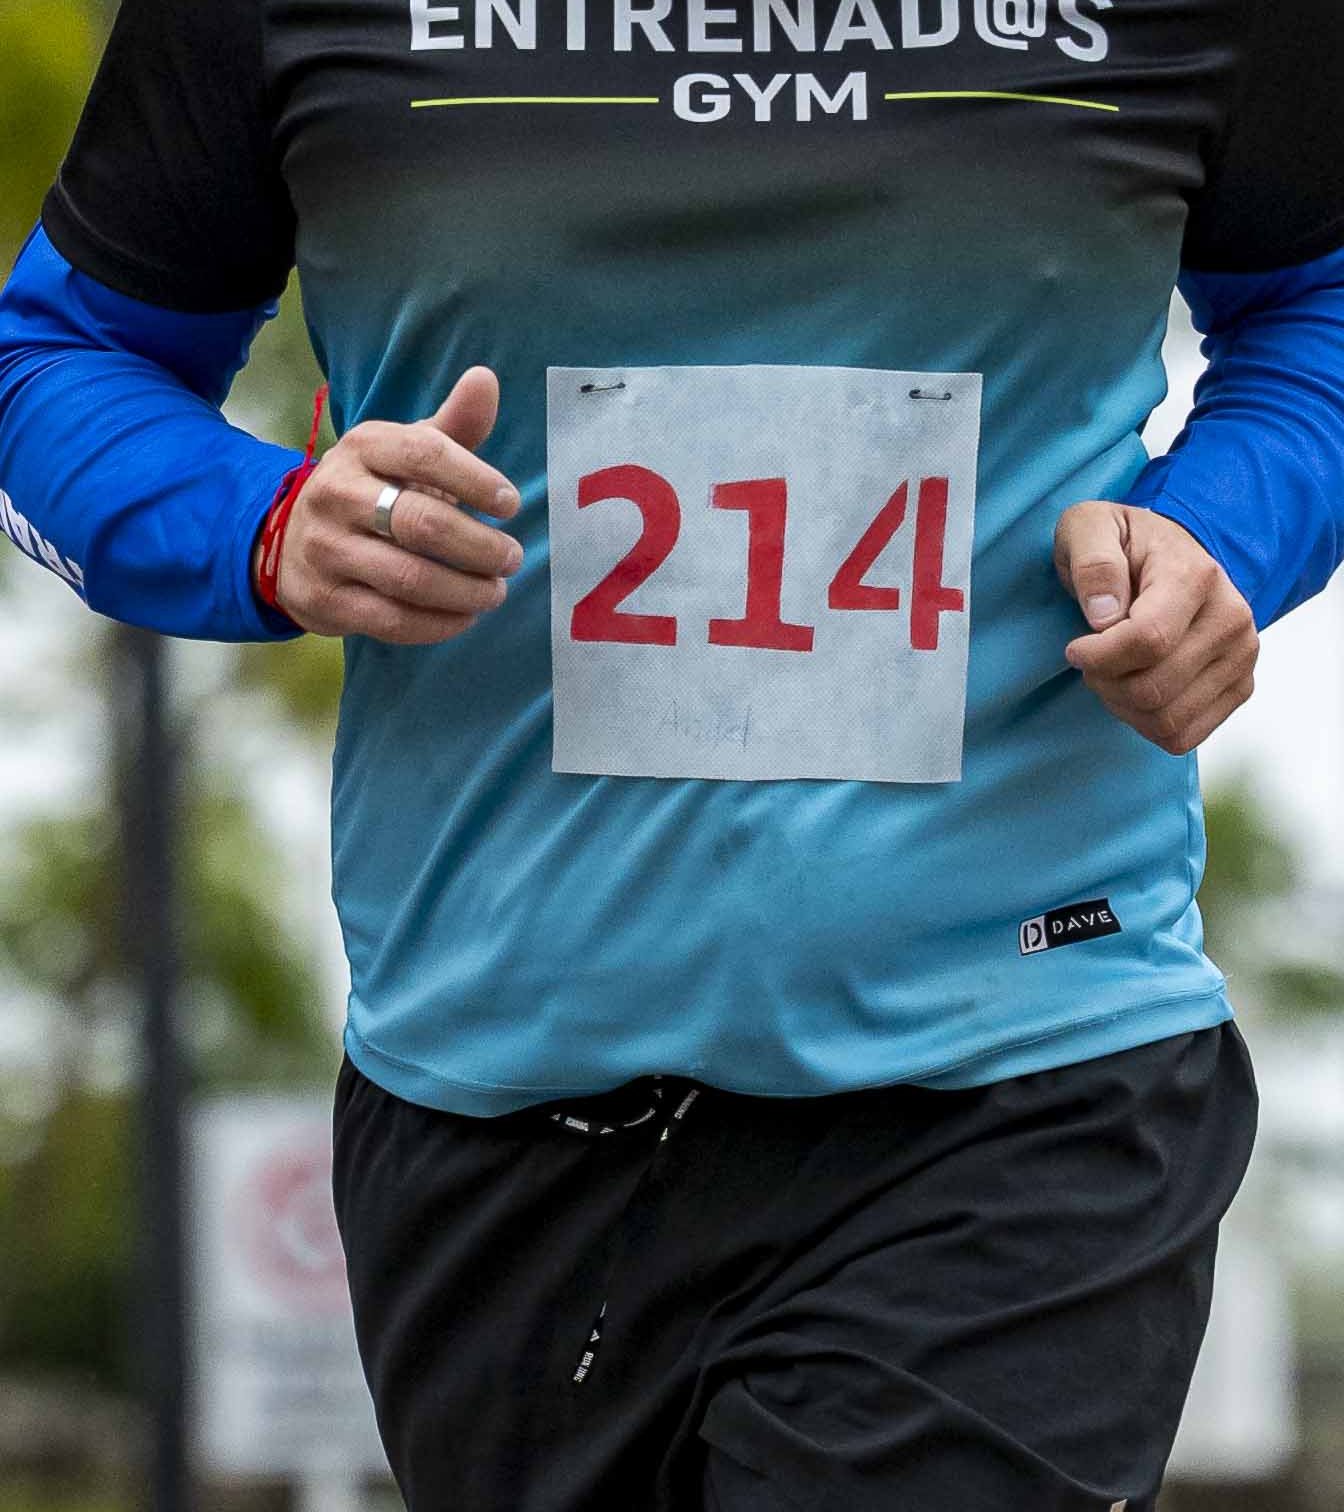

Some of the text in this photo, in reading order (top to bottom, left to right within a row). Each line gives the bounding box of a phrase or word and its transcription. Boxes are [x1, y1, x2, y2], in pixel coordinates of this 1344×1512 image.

[672, 72, 868, 122] GYM
[570, 463, 964, 652] 214
[1051, 909, 1113, 934] DAVE
